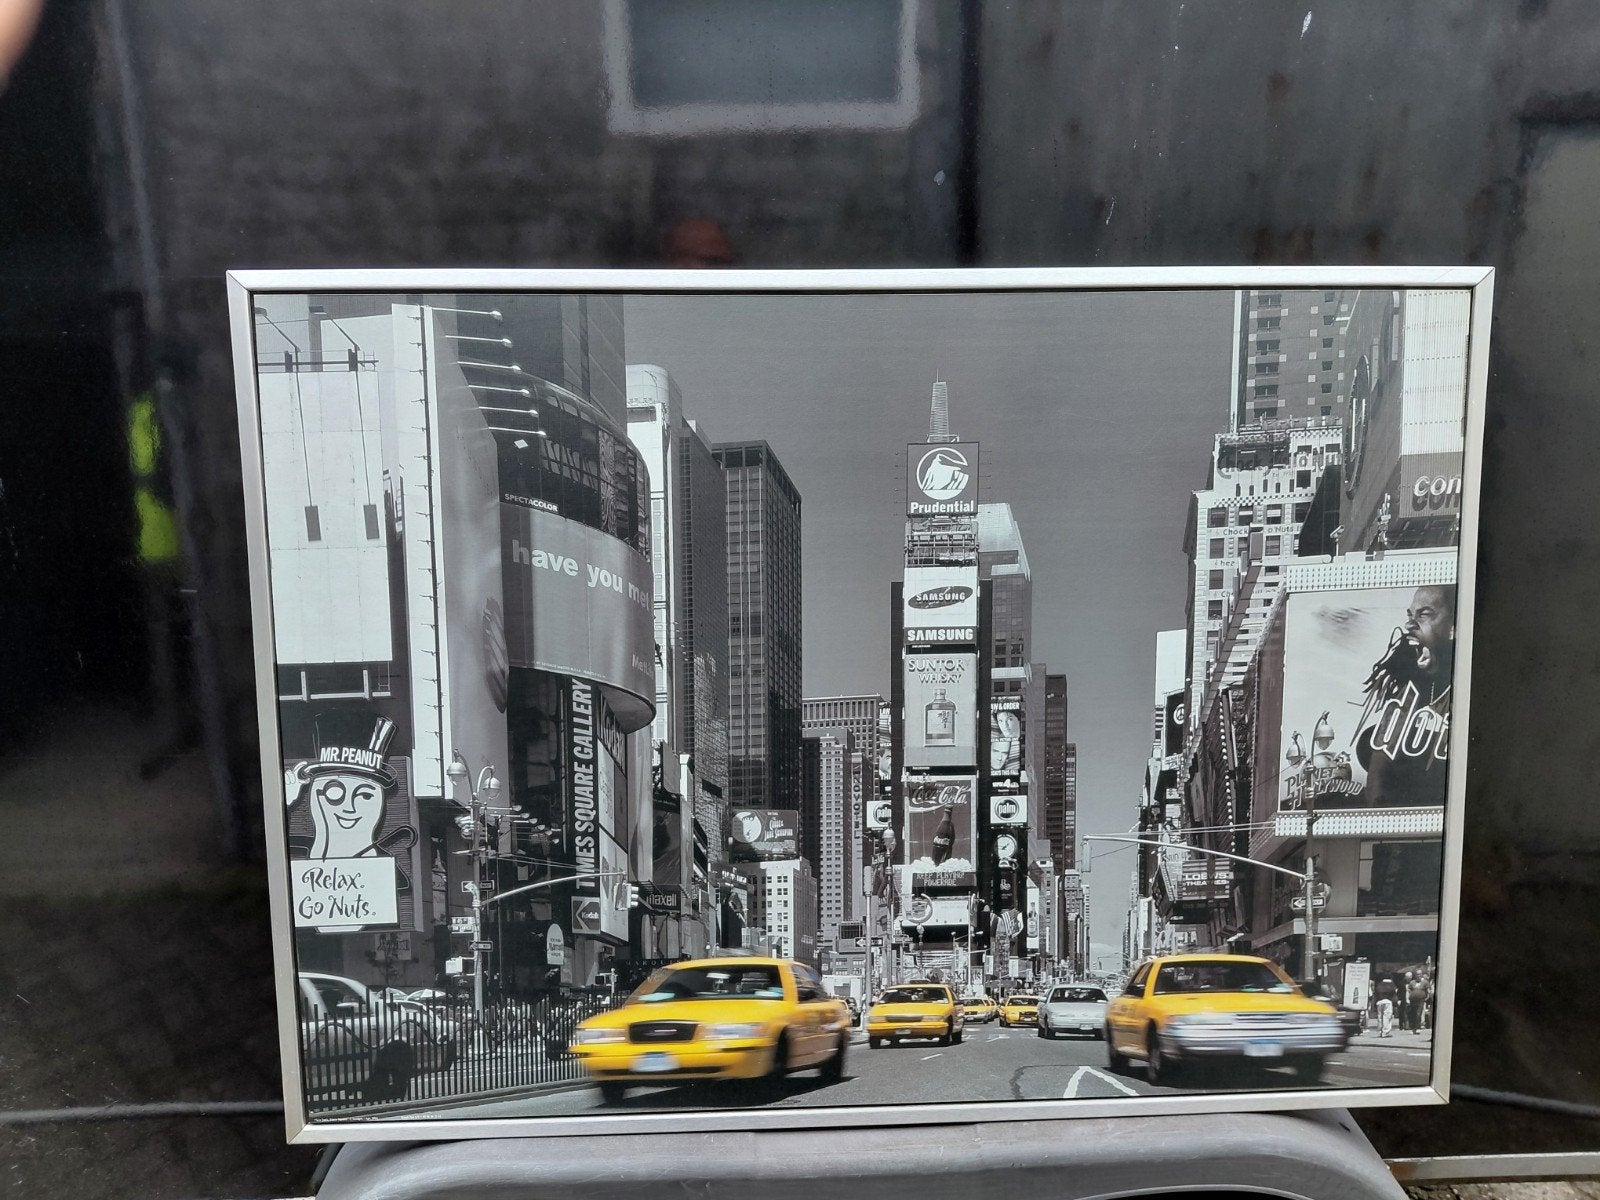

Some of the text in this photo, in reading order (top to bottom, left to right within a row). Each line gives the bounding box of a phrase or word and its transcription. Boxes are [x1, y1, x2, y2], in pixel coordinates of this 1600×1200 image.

[504, 493, 560, 512] SPECTACOLOR
[909, 500, 975, 514] Prudential
[512, 540, 579, 577] have
[586, 563, 624, 594] you
[915, 591, 966, 601] SAMSUNG
[907, 628, 974, 642] SAMSUNG
[319, 747, 383, 769] MR. PEANUT
[571, 678, 595, 889] TIMES SQUARE GALLERY
[998, 802, 1016, 814] palm
[301, 866, 366, 893] Relax.
[923, 879, 958, 887] POWERADE
[1184, 872, 1228, 880] LOEWS
[298, 893, 377, 920] Go Nuts.
[646, 893, 678, 907] maxell
[581, 911, 600, 919] Kodak
